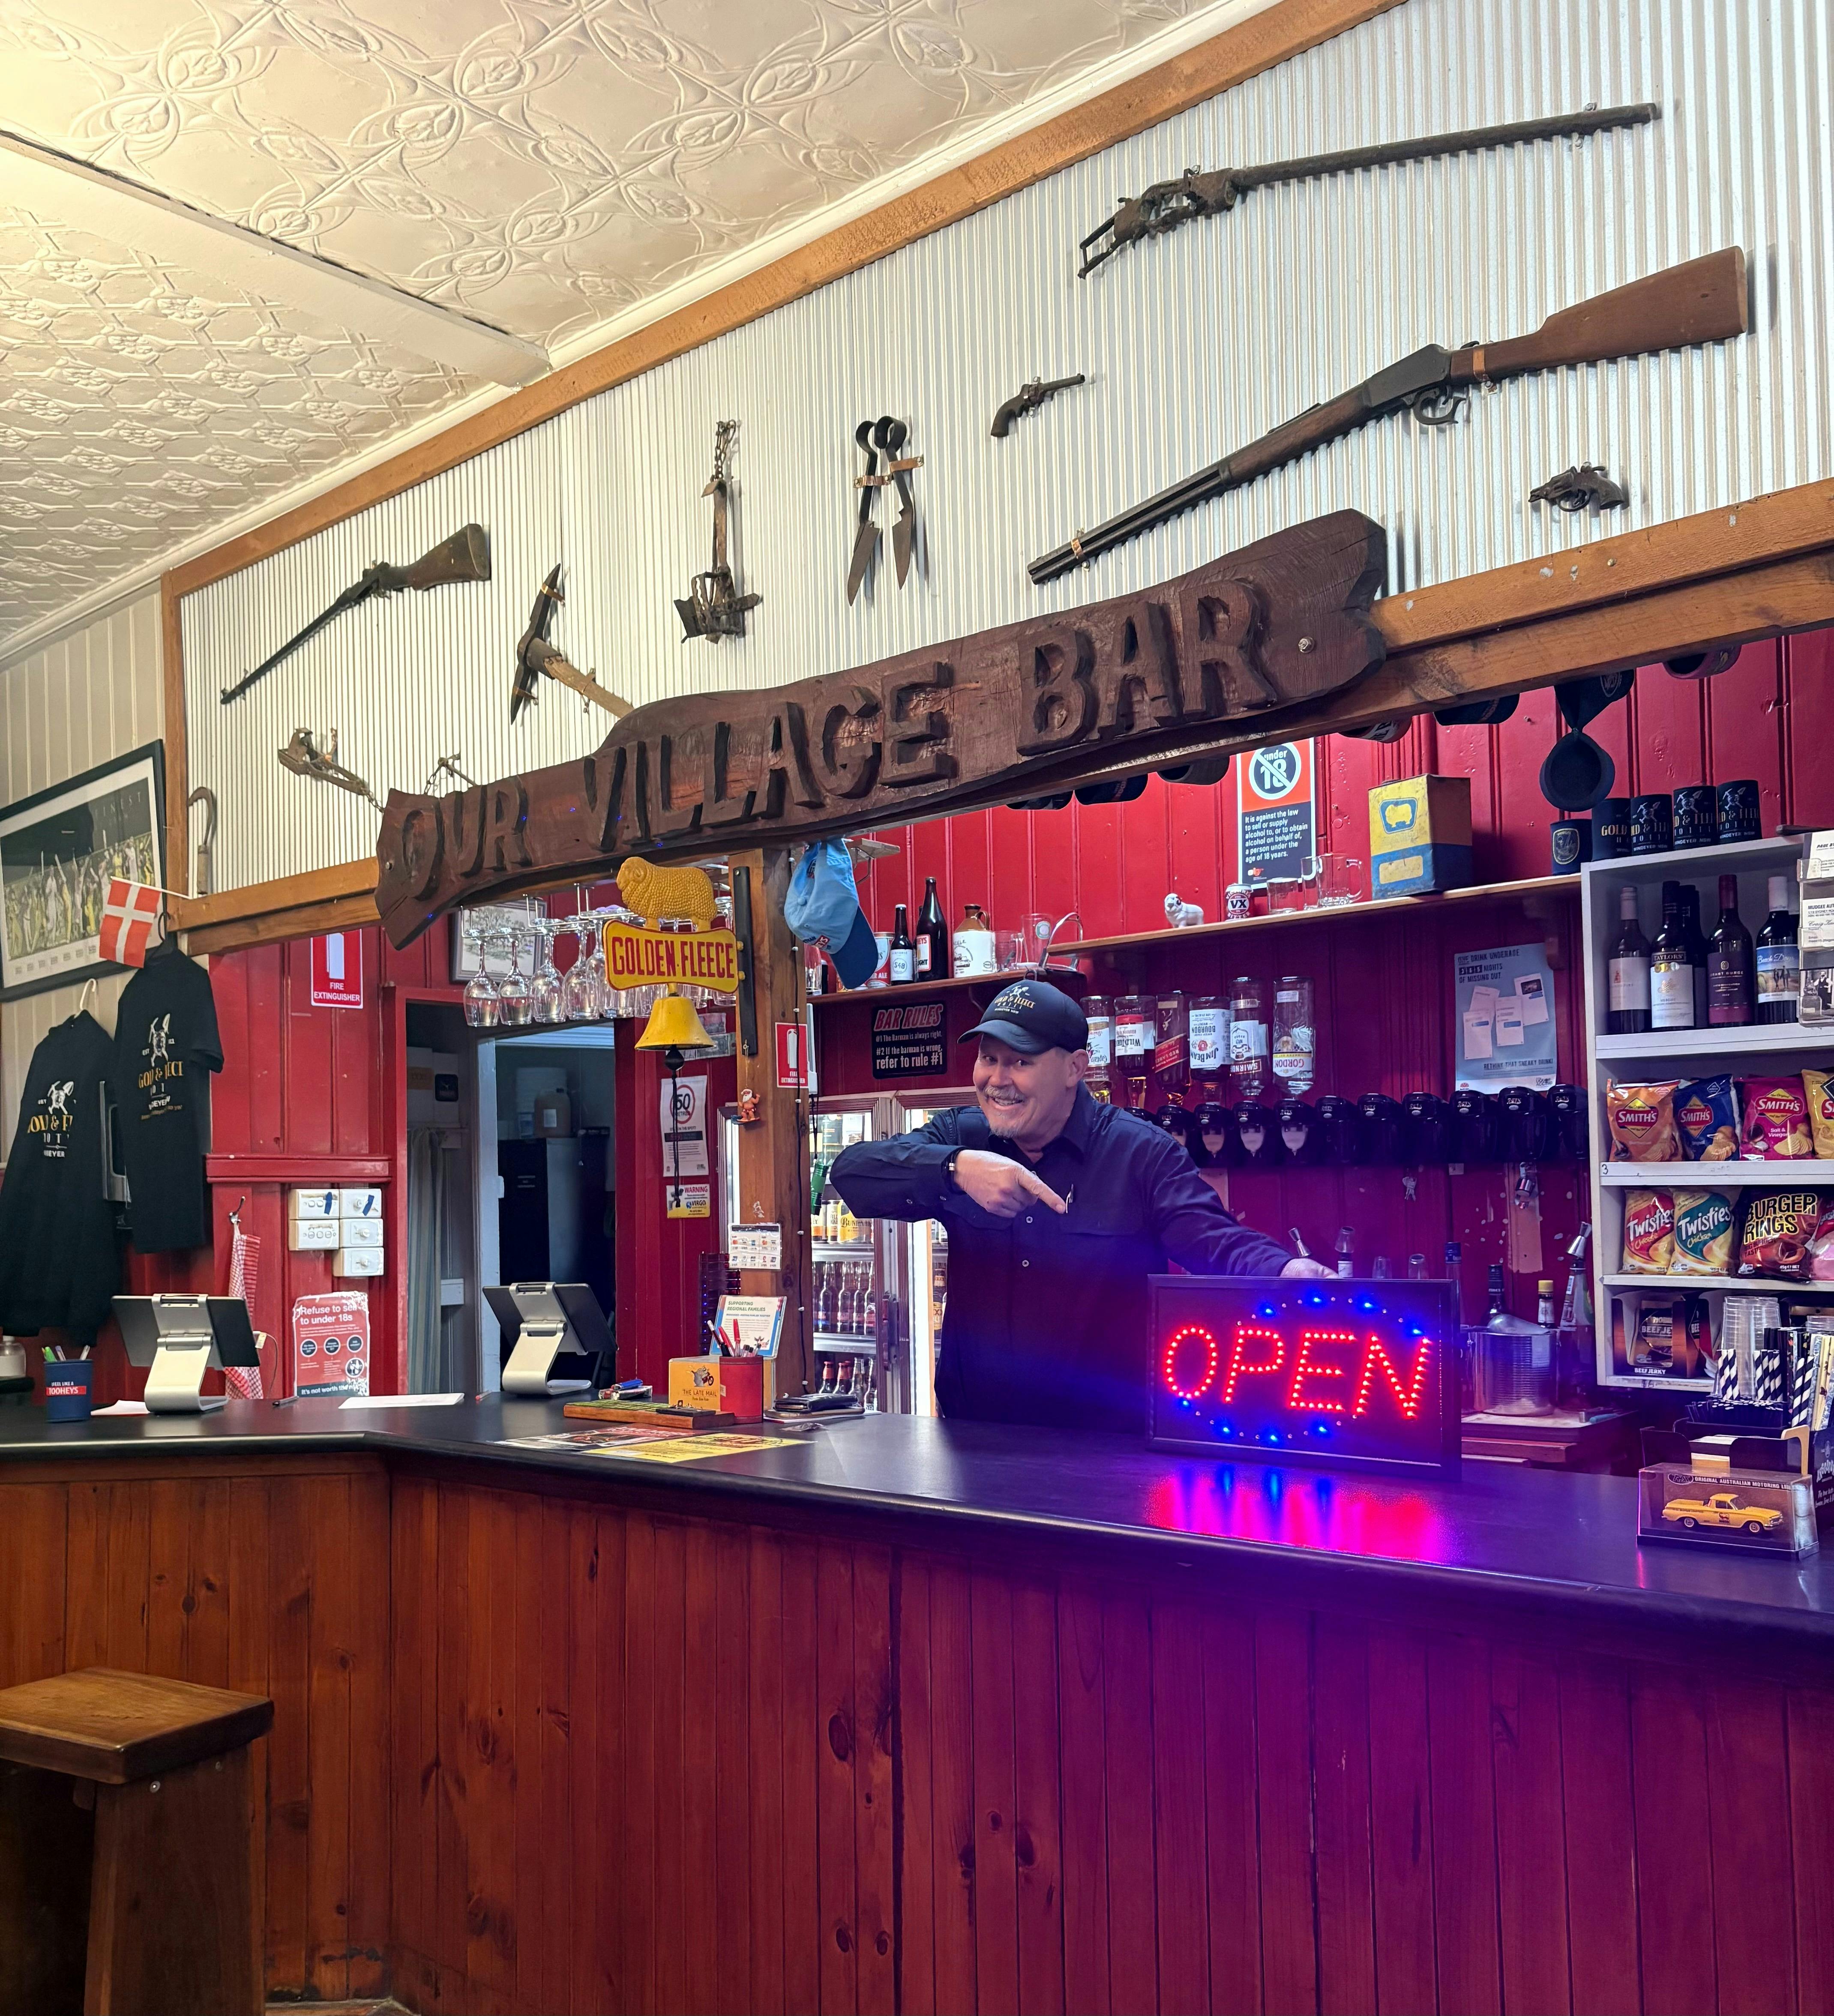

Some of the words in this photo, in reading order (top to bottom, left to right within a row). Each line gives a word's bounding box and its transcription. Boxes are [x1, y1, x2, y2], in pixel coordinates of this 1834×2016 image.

[402, 784, 529, 896] OUR
[584, 662, 957, 852] VILLAGE
[1016, 579, 1277, 756] BAR
[1264, 749, 1288, 761] under
[1261, 759, 1287, 789] 18
[1256, 813, 1276, 822] against
[1269, 818, 1288, 827] supply
[1245, 830, 1265, 839] alcohol
[1289, 823, 1308, 832] obtain
[1601, 824, 1627, 836] GOLD
[1245, 837, 1265, 847] alcohol
[1275, 833, 1293, 842] behalf
[1250, 846, 1269, 855] person
[1271, 851, 1288, 860] years.
[1230, 899, 1247, 908] VX
[611, 936, 677, 977] GOLDEN
[680, 941, 735, 978] FLEECE
[1471, 953, 1487, 962] DRINK
[1489, 949, 1520, 960] UNDERAGE
[1483, 964, 1503, 972] NIGHTS
[1468, 974, 1489, 983] MISSING
[330, 982, 344, 990] FIRE
[314, 991, 360, 1002] EXTINGUISHER
[874, 1008, 903, 1031] BAR
[902, 1004, 944, 1029] RULES
[1192, 1025, 1216, 1033] BOURBON
[914, 1031, 929, 1040] always
[886, 1047, 890, 1055] If
[901, 1046, 919, 1054] barman
[920, 1044, 925, 1052] is
[1208, 1047, 1219, 1062] JIM
[877, 1056, 898, 1069] refer
[901, 1055, 909, 1068] to
[912, 1053, 928, 1067] rule
[931, 1052, 942, 1065] #1
[1484, 1062, 1504, 1070] RETHINK
[1757, 1099, 1800, 1112] SMITH'S
[1618, 1111, 1657, 1123] SMITH'S
[1681, 1109, 1710, 1123] SMITH'S
[1747, 1193, 1818, 1223] BURGER
[1678, 1206, 1732, 1240] Twisties
[1744, 1214, 1799, 1245] RINGS
[1687, 1232, 1712, 1248] Chicken
[301, 1305, 330, 1315] Refuse
[300, 1317, 309, 1325] to
[312, 1315, 336, 1324] under
[339, 1314, 353, 1322] 18s
[1642, 1326, 1660, 1334] BEEF
[1165, 1325, 1432, 1420] OPEN
[48, 1387, 78, 1395] TOOHEYS
[1719, 1478, 1751, 1486] AUSTRALIAN
